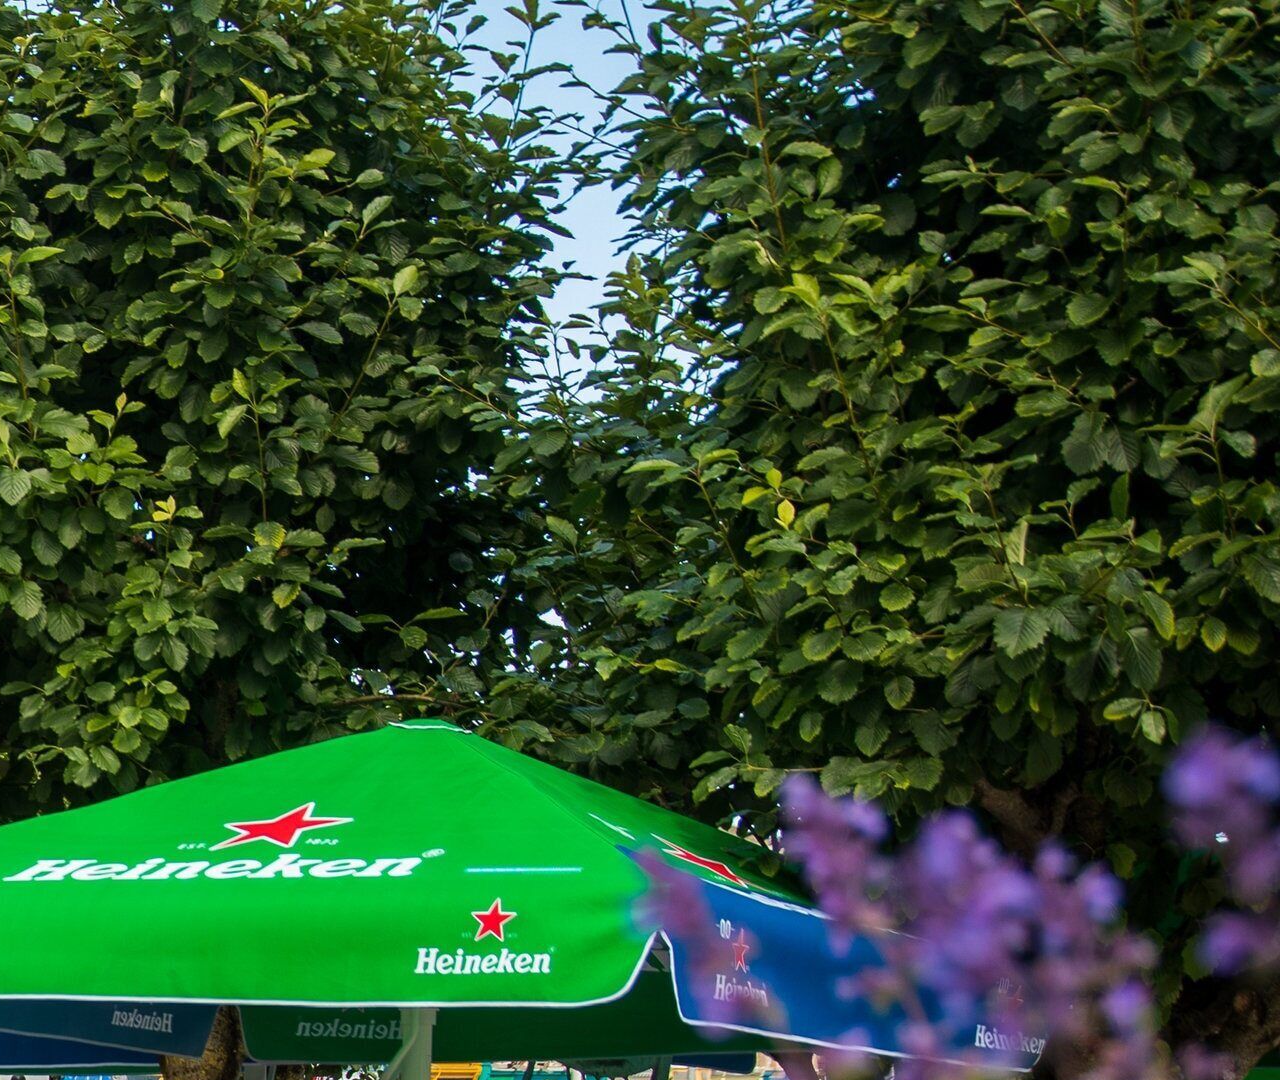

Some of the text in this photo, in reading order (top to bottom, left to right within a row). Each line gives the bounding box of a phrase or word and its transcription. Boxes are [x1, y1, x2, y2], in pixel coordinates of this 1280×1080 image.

[3, 852, 422, 882] Heineken
[414, 947, 551, 974] Heineken
[974, 1023, 1047, 1054] Heinken
